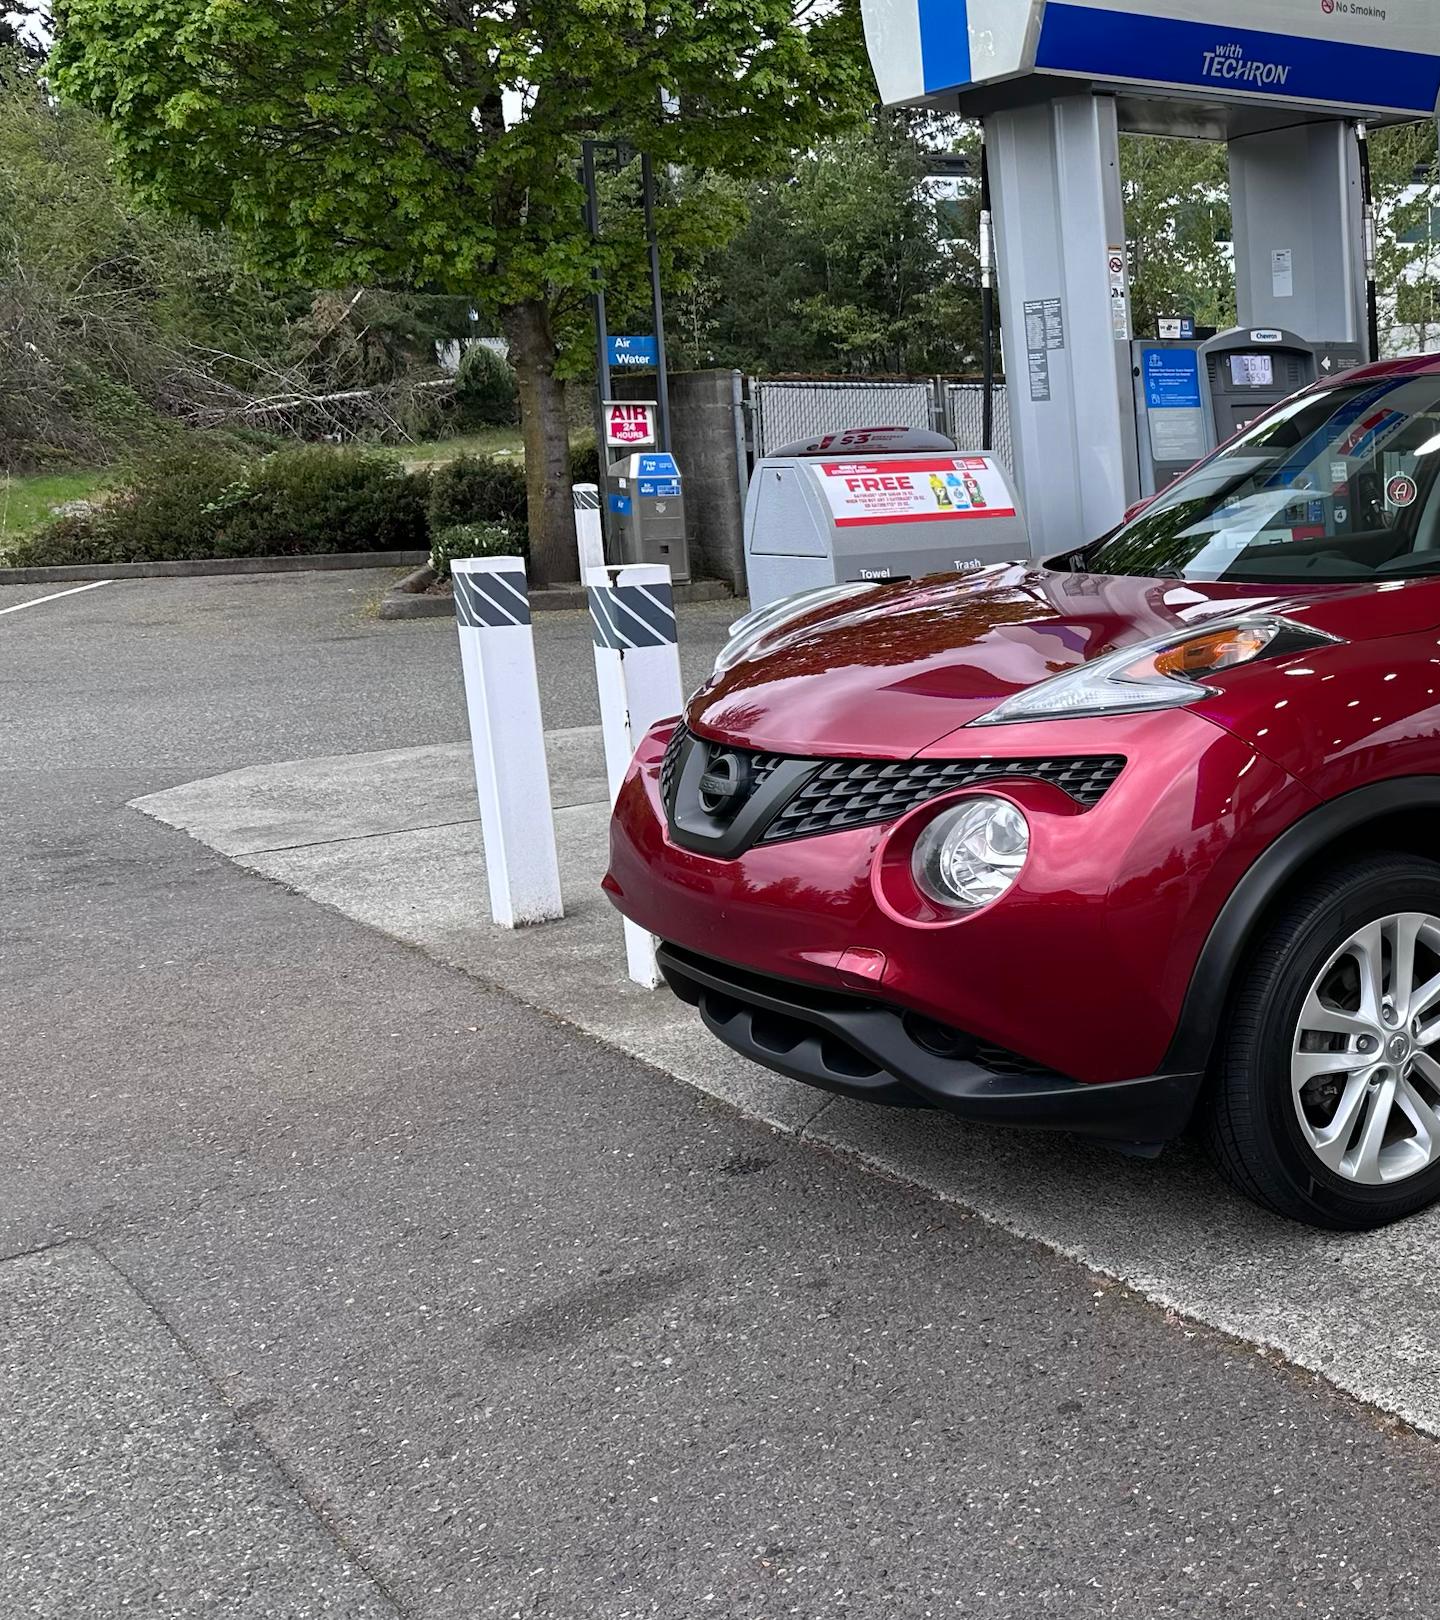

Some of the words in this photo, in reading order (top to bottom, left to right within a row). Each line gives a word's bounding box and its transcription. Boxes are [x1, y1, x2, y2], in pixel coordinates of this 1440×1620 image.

[1336, 1, 1348, 13] No
[1350, 3, 1386, 21] Smoking
[1215, 43, 1243, 58] with
[1202, 52, 1289, 86] TECHRON
[615, 338, 631, 348] Air
[616, 353, 650, 364] Water
[611, 405, 647, 421] AIR
[623, 423, 636, 431] 24
[845, 476, 915, 492] FREE
[954, 559, 981, 570] Trash
[860, 568, 891, 579] Towel
